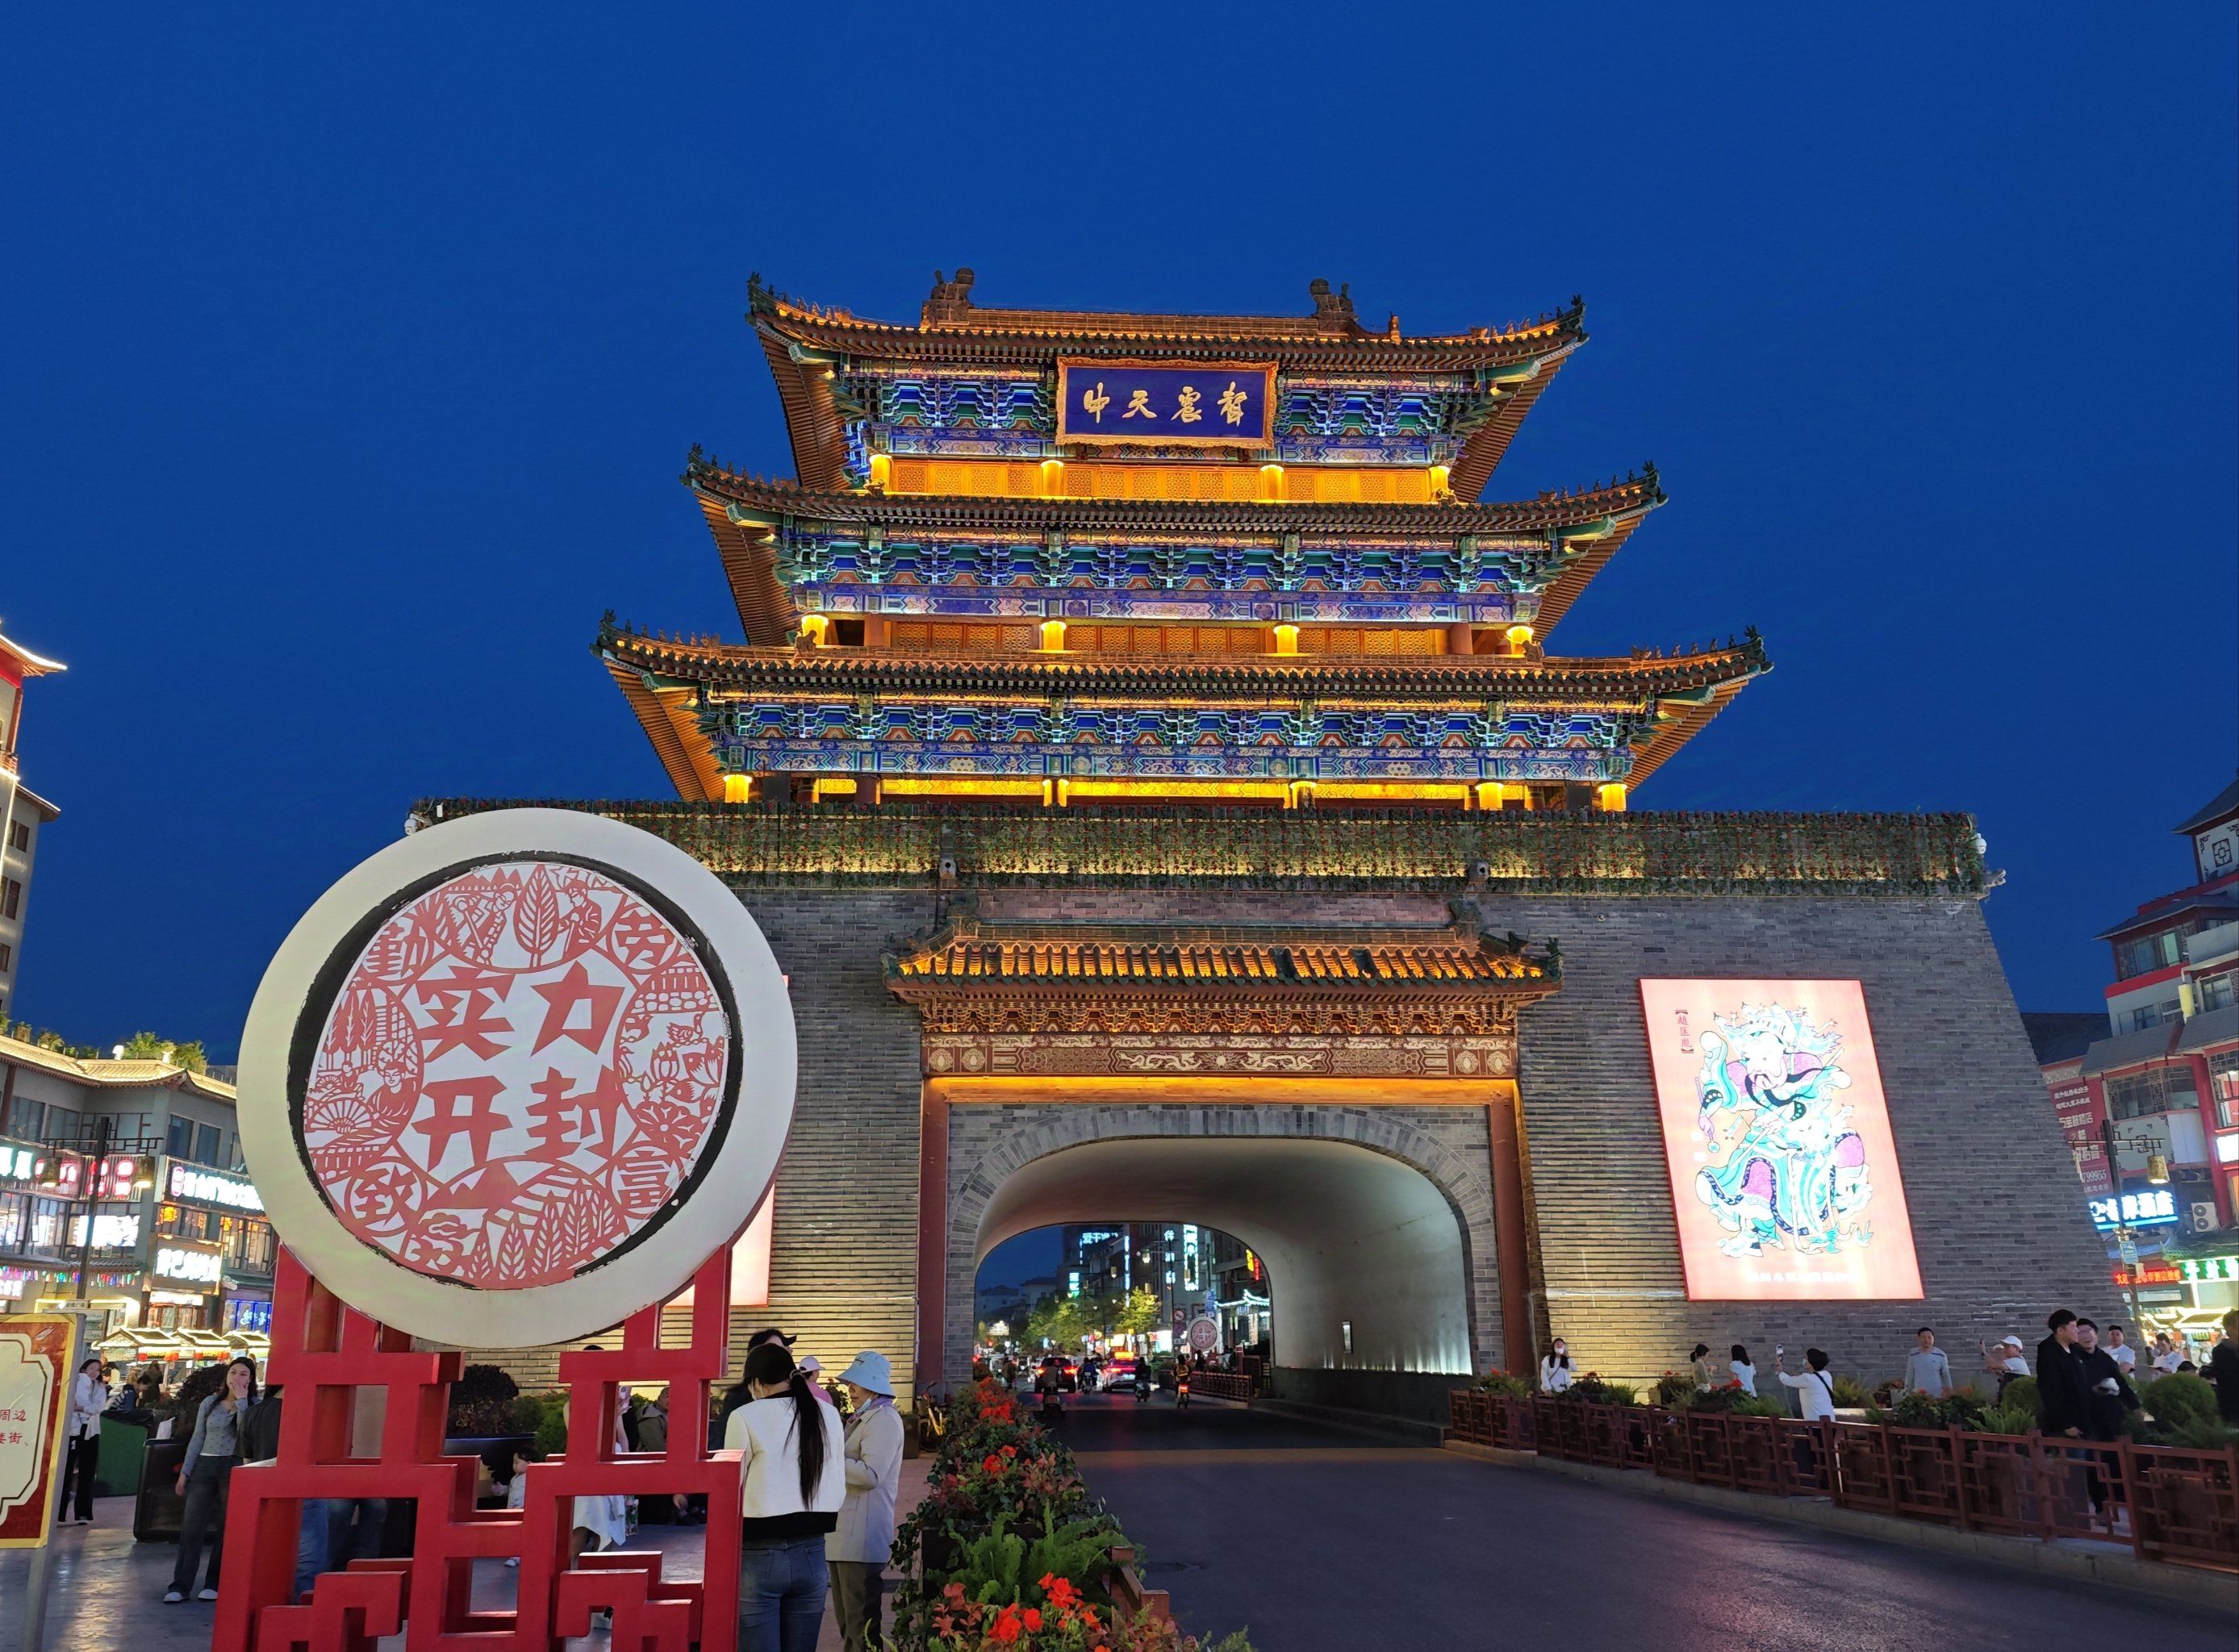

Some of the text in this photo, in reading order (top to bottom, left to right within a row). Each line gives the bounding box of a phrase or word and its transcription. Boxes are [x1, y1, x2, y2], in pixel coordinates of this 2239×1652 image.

[416, 961, 625, 1062] 实力
[411, 1064, 627, 1172] 开封
[353, 1150, 673, 1226] 致 富
